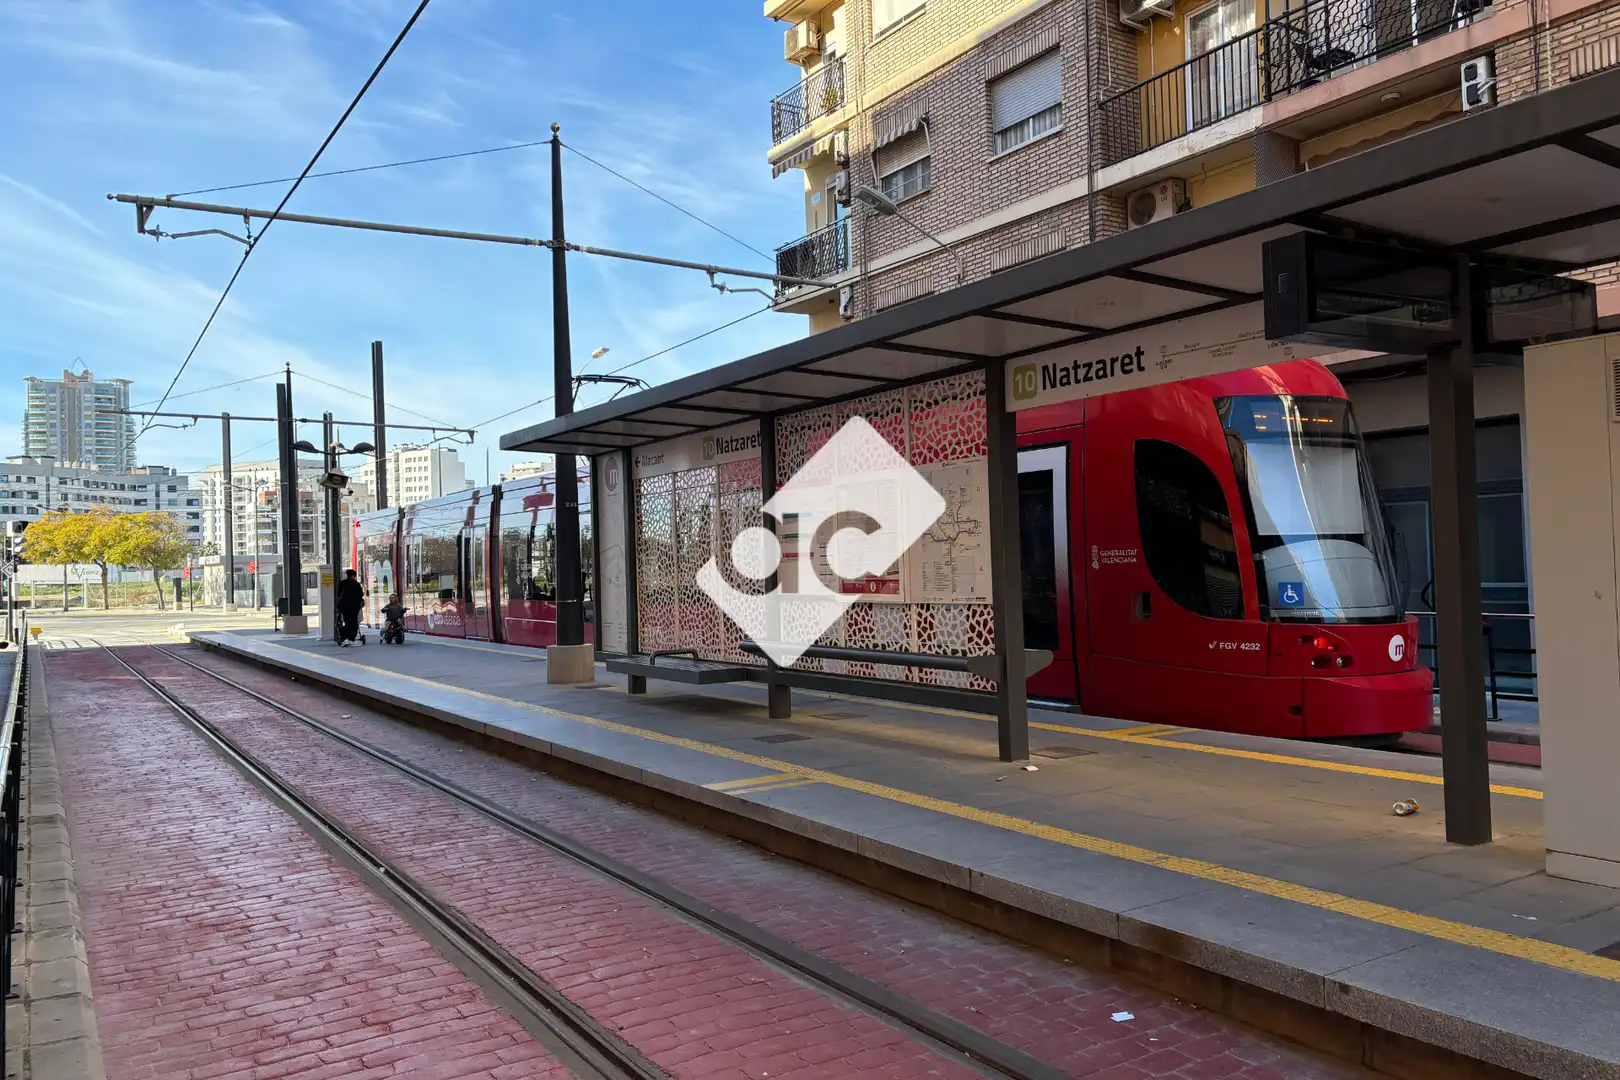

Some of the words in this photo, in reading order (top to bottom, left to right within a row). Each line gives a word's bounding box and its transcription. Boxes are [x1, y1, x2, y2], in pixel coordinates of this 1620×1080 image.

[1014, 370, 1036, 393] 10
[1041, 345, 1145, 390] Natzaret
[703, 440, 714, 456] 10
[716, 431, 762, 455] Natzaret
[641, 452, 665, 468] Alacant
[1219, 642, 1238, 650] FGV
[1240, 642, 1261, 650] 4232
